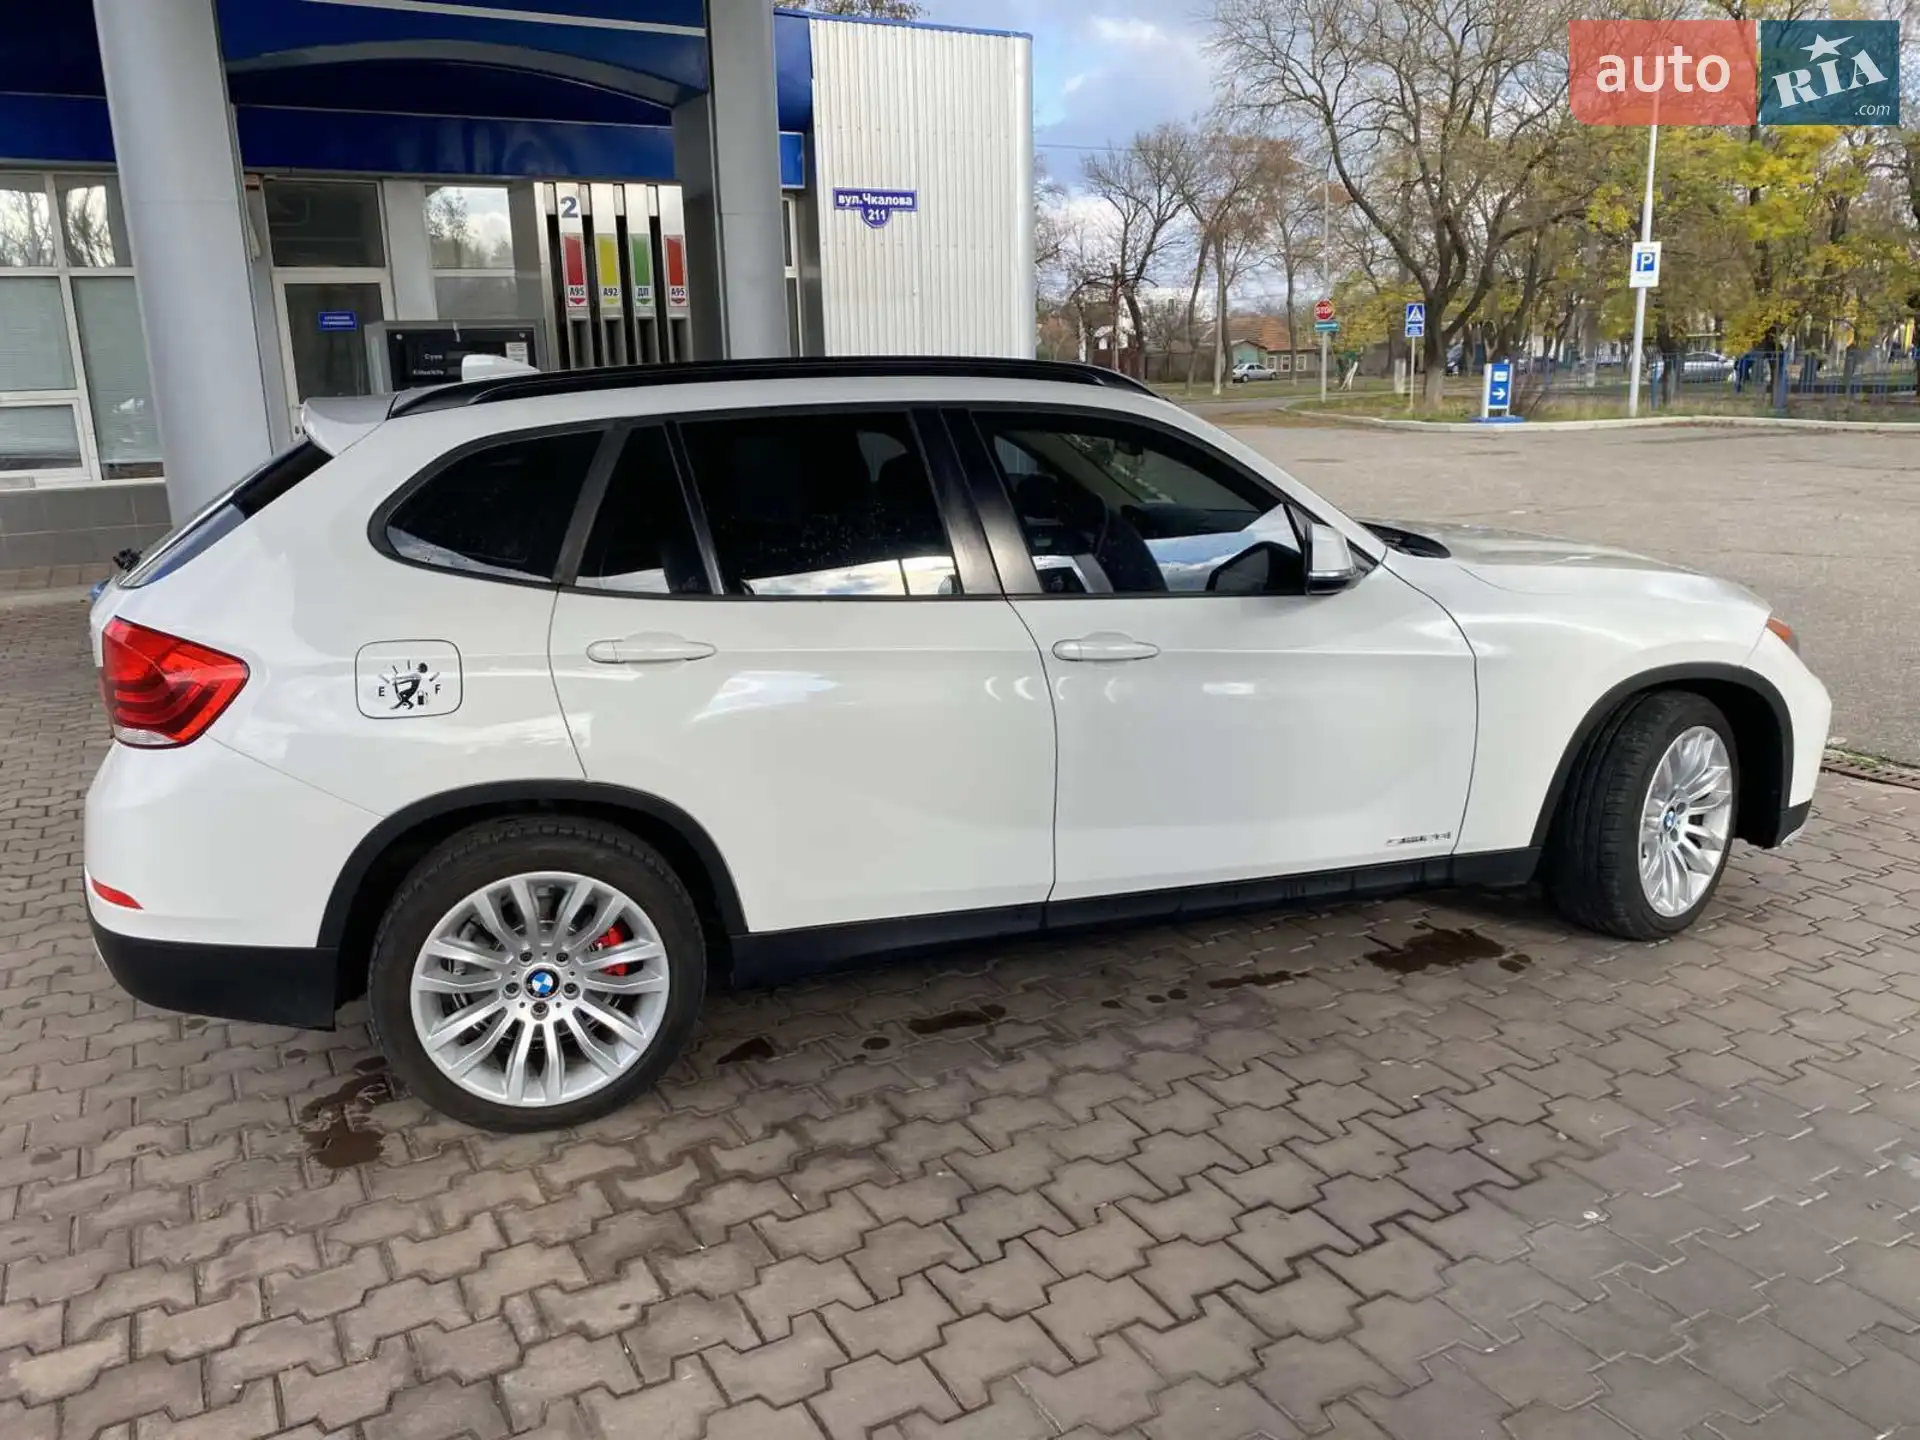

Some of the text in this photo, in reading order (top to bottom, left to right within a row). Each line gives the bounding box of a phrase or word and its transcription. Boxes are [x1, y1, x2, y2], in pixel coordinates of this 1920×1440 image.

[560, 196, 579, 218] 2
[868, 209, 886, 221] 211
[1640, 253, 1653, 272] P
[378, 686, 385, 697] E
[435, 684, 441, 694] F
